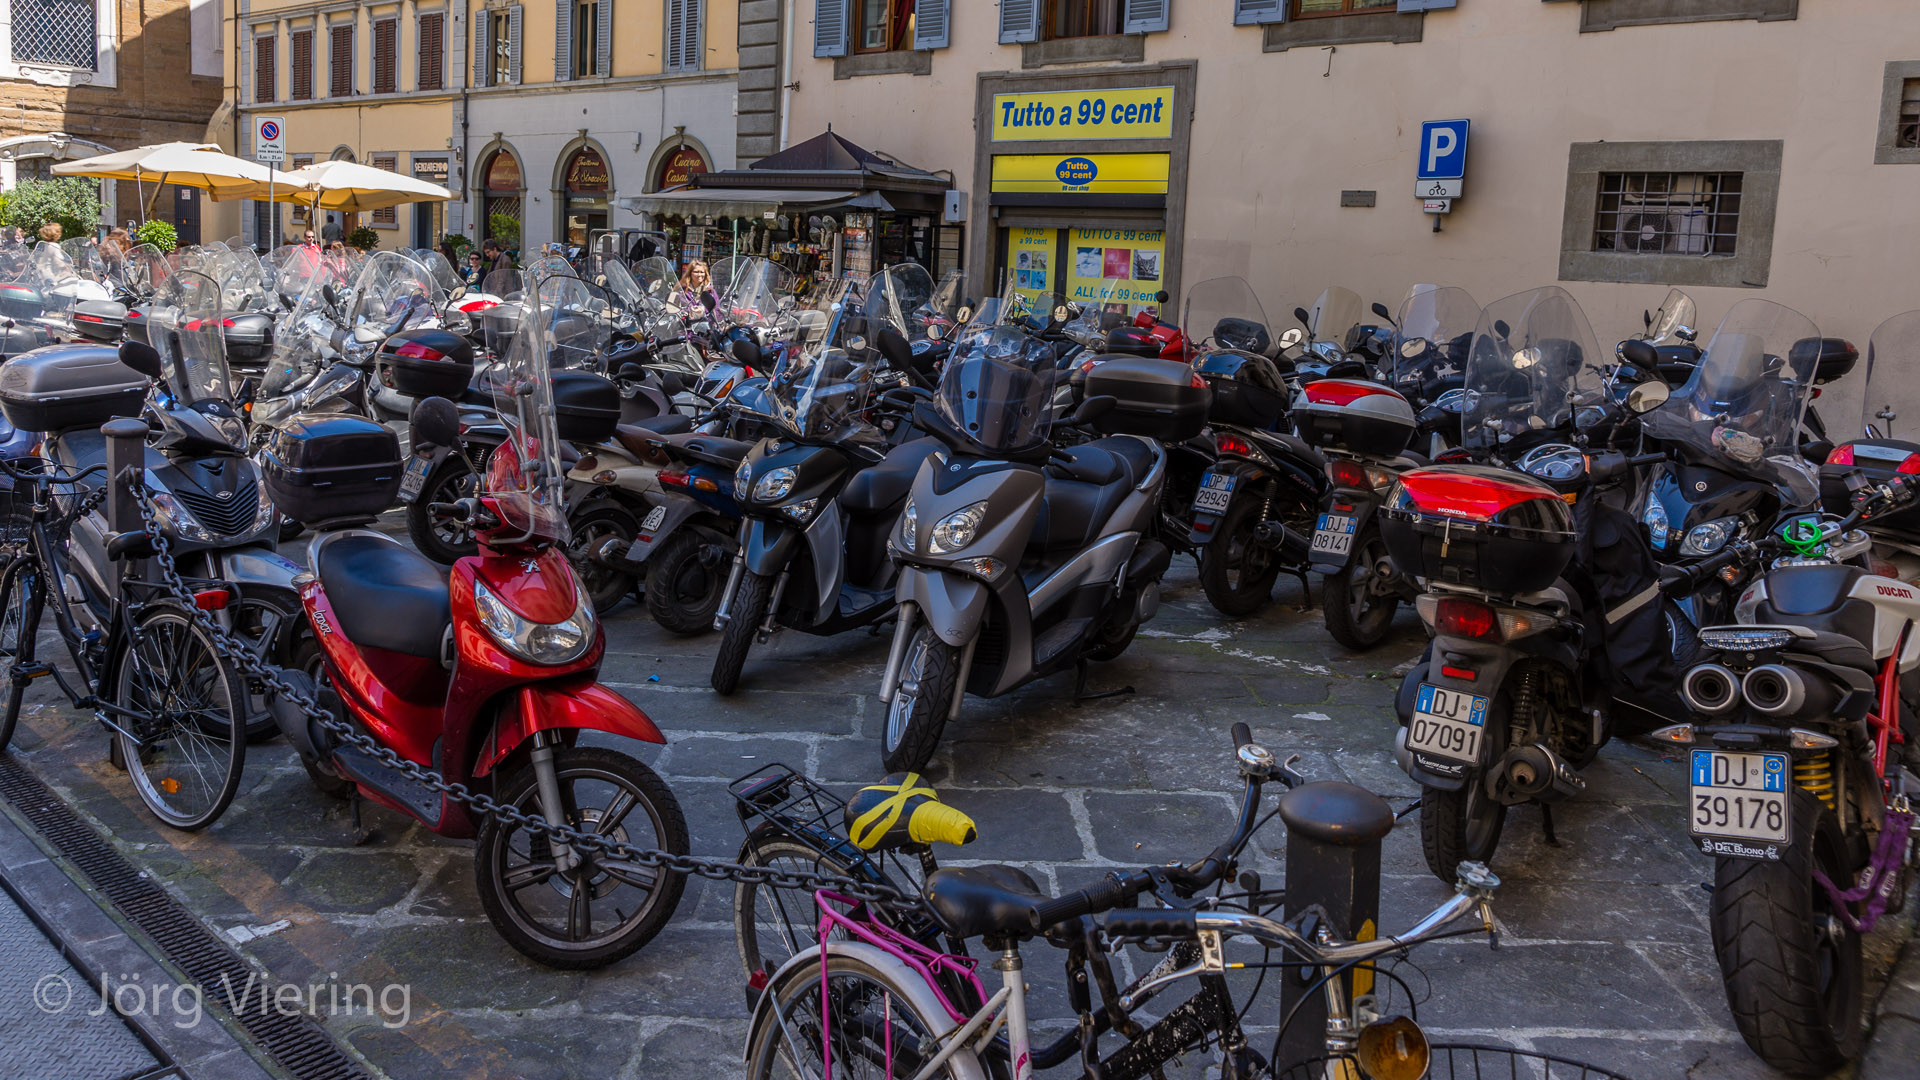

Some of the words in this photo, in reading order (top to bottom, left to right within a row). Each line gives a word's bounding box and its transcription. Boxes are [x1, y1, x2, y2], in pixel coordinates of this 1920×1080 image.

[1001, 101, 1055, 127] Tutto
[1059, 105, 1072, 126] a
[1077, 98, 1106, 125] 99
[1111, 97, 1163, 124] cent
[1427, 127, 1457, 172] P
[674, 154, 701, 167] Cucina
[1066, 162, 1089, 170] Tutto
[1060, 170, 1070, 179] 99
[1072, 171, 1092, 179] cent
[1025, 237, 1033, 245] 99
[1114, 231, 1121, 240] a
[1123, 230, 1136, 241] 99
[1138, 230, 1162, 242] cent
[1099, 287, 1113, 299] for
[1117, 288, 1130, 300] 99
[1209, 474, 1223, 488] DP
[1196, 490, 1229, 507] 29949
[1437, 507, 1467, 516] HONDA
[1326, 516, 1342, 531] DJ
[1313, 533, 1349, 551] 08141
[1876, 585, 1913, 600] DUCATI
[1432, 690, 1460, 718] DJ
[1470, 710, 1482, 724] FI
[1413, 719, 1477, 756] 07091
[1714, 755, 1747, 786] DJ
[1765, 773, 1779, 789] FI
[1695, 794, 1783, 831] 39178
